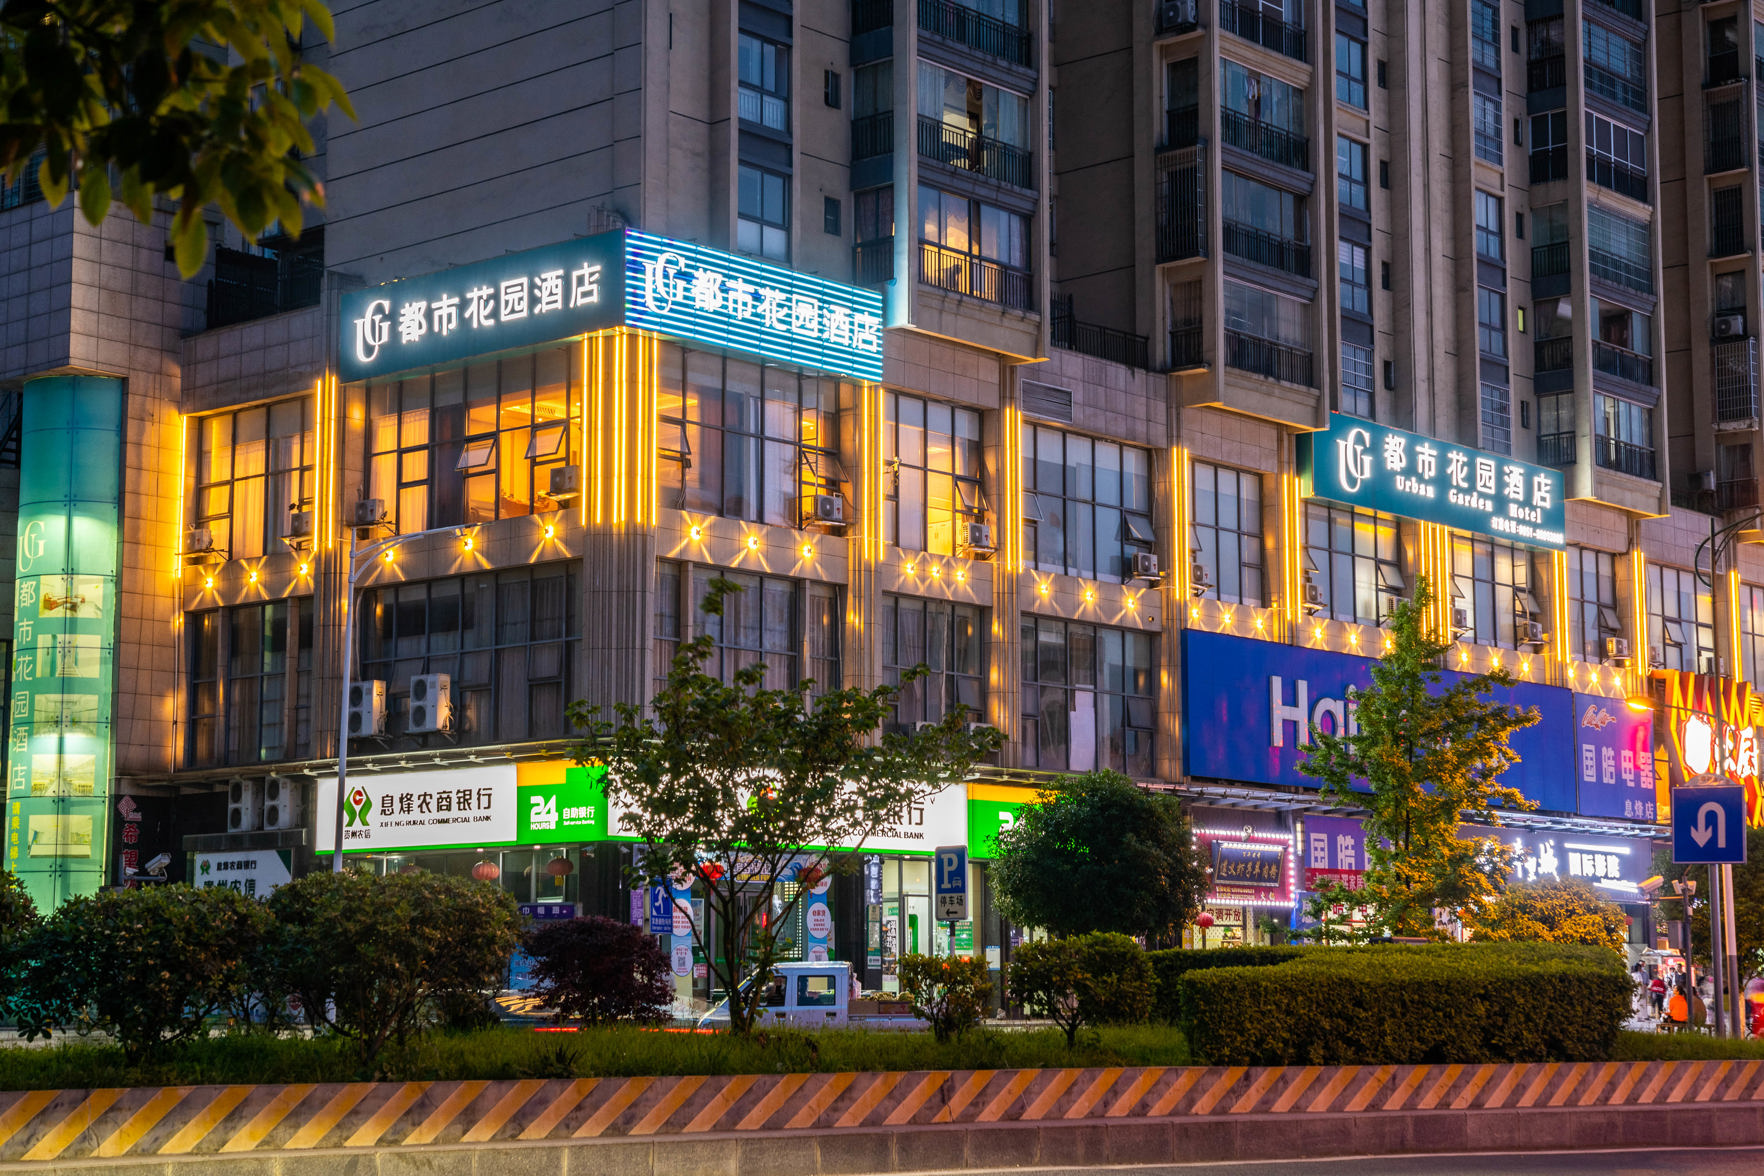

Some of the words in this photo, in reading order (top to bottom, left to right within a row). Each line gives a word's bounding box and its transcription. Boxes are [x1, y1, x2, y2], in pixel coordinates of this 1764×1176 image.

[397, 262, 603, 344] 都市花园酒店
[690, 268, 881, 354] 都市花园酒店
[1383, 434, 1552, 509] 都市花园酒店
[1395, 475, 1435, 498] Urban
[1449, 489, 1493, 512] Garden
[1508, 503, 1542, 524] Hotel
[11, 580, 37, 791] 都市花园酒店
[1582, 743, 1654, 790] 国皓电器
[379, 787, 493, 816] 息烽农商银行
[530, 794, 559, 829] 24
[562, 805, 595, 819] 自助银行
[1624, 799, 1654, 819] 息烽店
[344, 829, 371, 840] 贵州农信
[405, 819, 426, 827] RURAL
[427, 816, 471, 826] COMMERCIAL
[472, 814, 492, 823] BANK
[904, 831, 925, 840] BANK
[941, 853, 959, 889] P
[940, 895, 964, 907] 停车场
